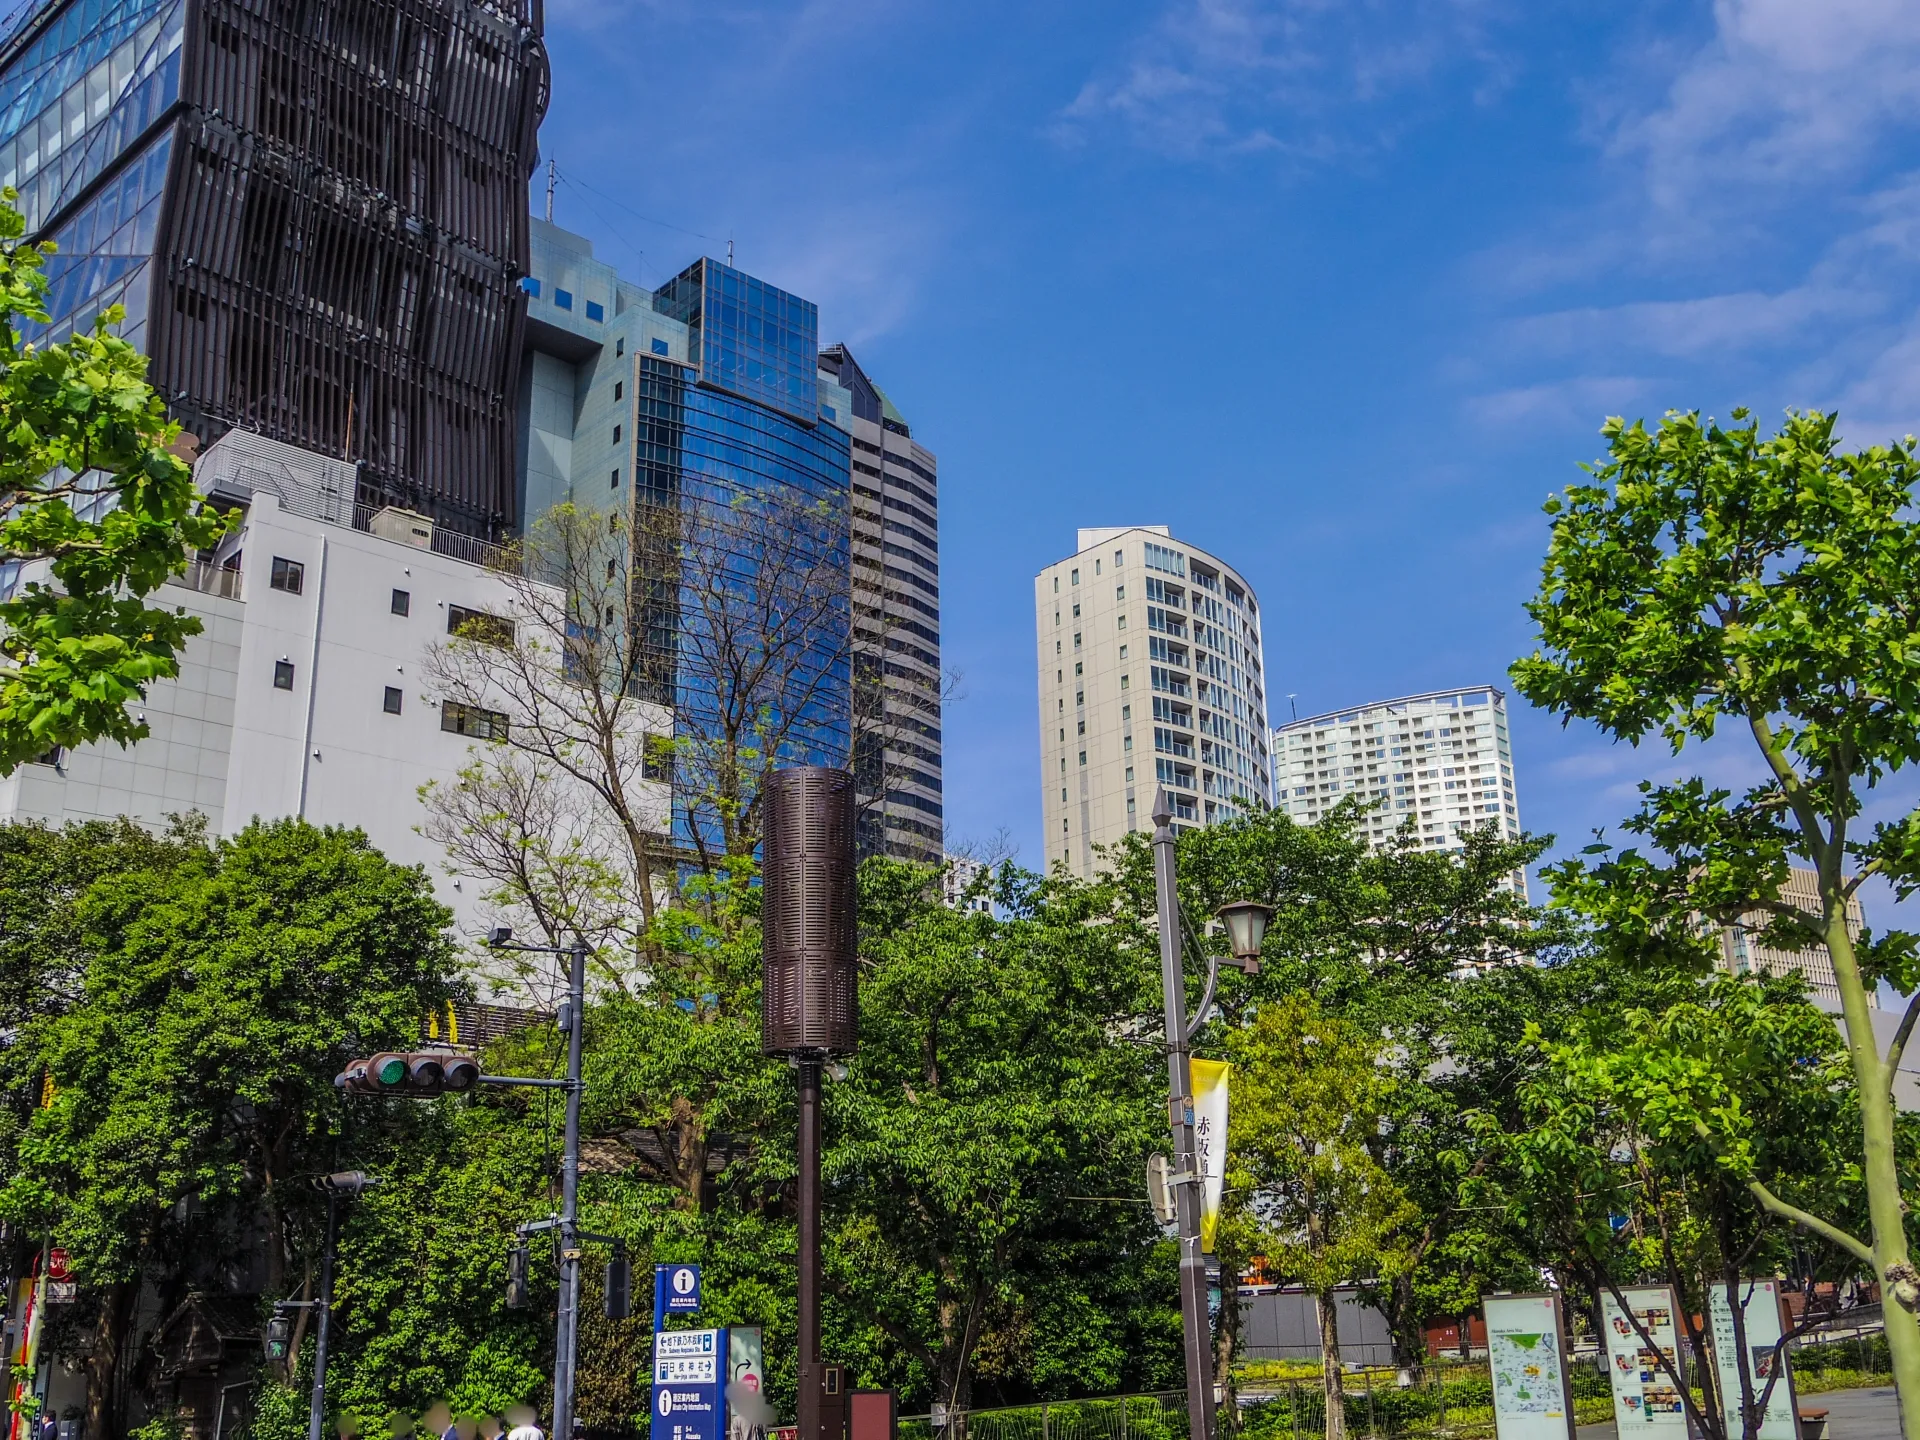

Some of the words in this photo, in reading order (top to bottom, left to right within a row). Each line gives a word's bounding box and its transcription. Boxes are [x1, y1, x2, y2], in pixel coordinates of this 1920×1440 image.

[667, 1334, 702, 1346] 地下鉄乃木坂駅
[681, 1346, 694, 1354] Nogizaka
[672, 1393, 700, 1402] 港区案内地図
